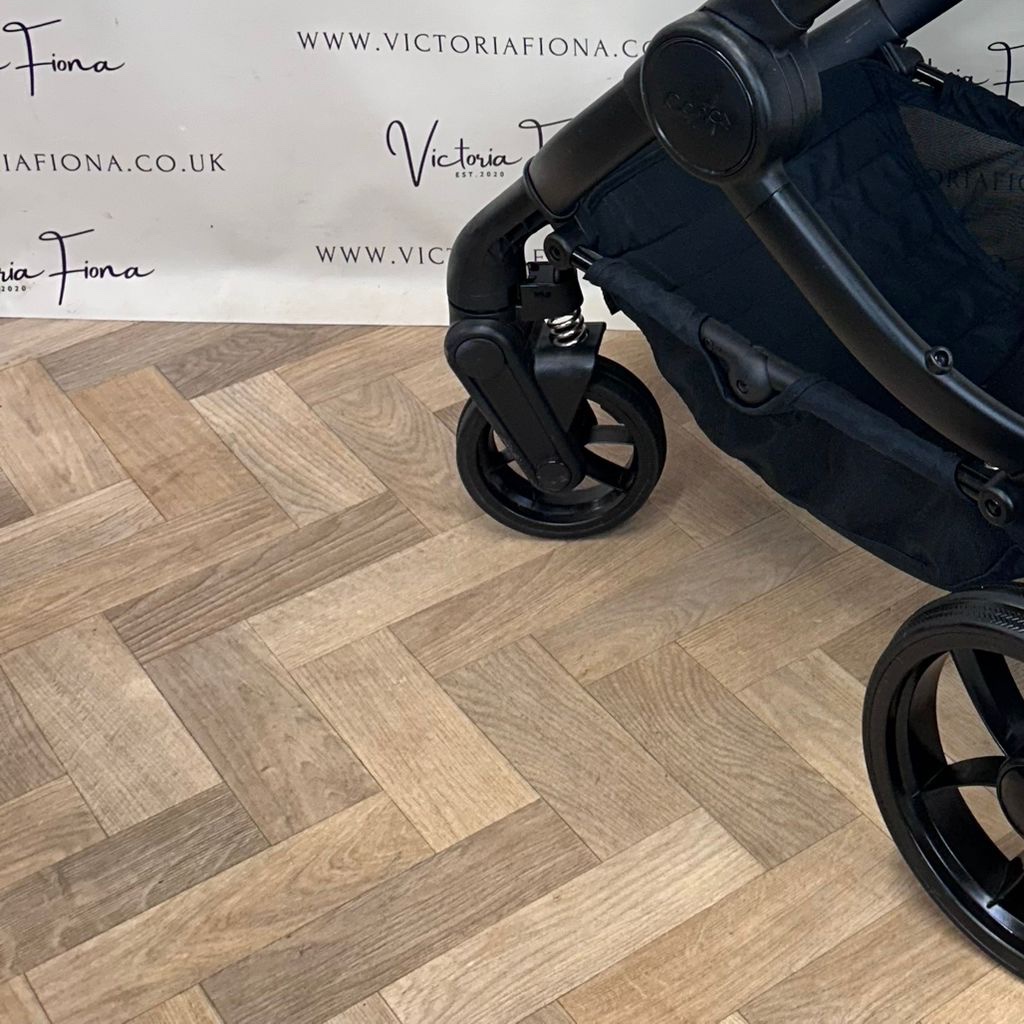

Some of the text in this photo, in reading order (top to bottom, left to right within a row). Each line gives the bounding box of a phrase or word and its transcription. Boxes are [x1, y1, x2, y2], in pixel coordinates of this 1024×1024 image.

[2, 19, 126, 97] Fiona
[386, 120, 523, 187] Victoria
[38, 229, 155, 306] Fiona
